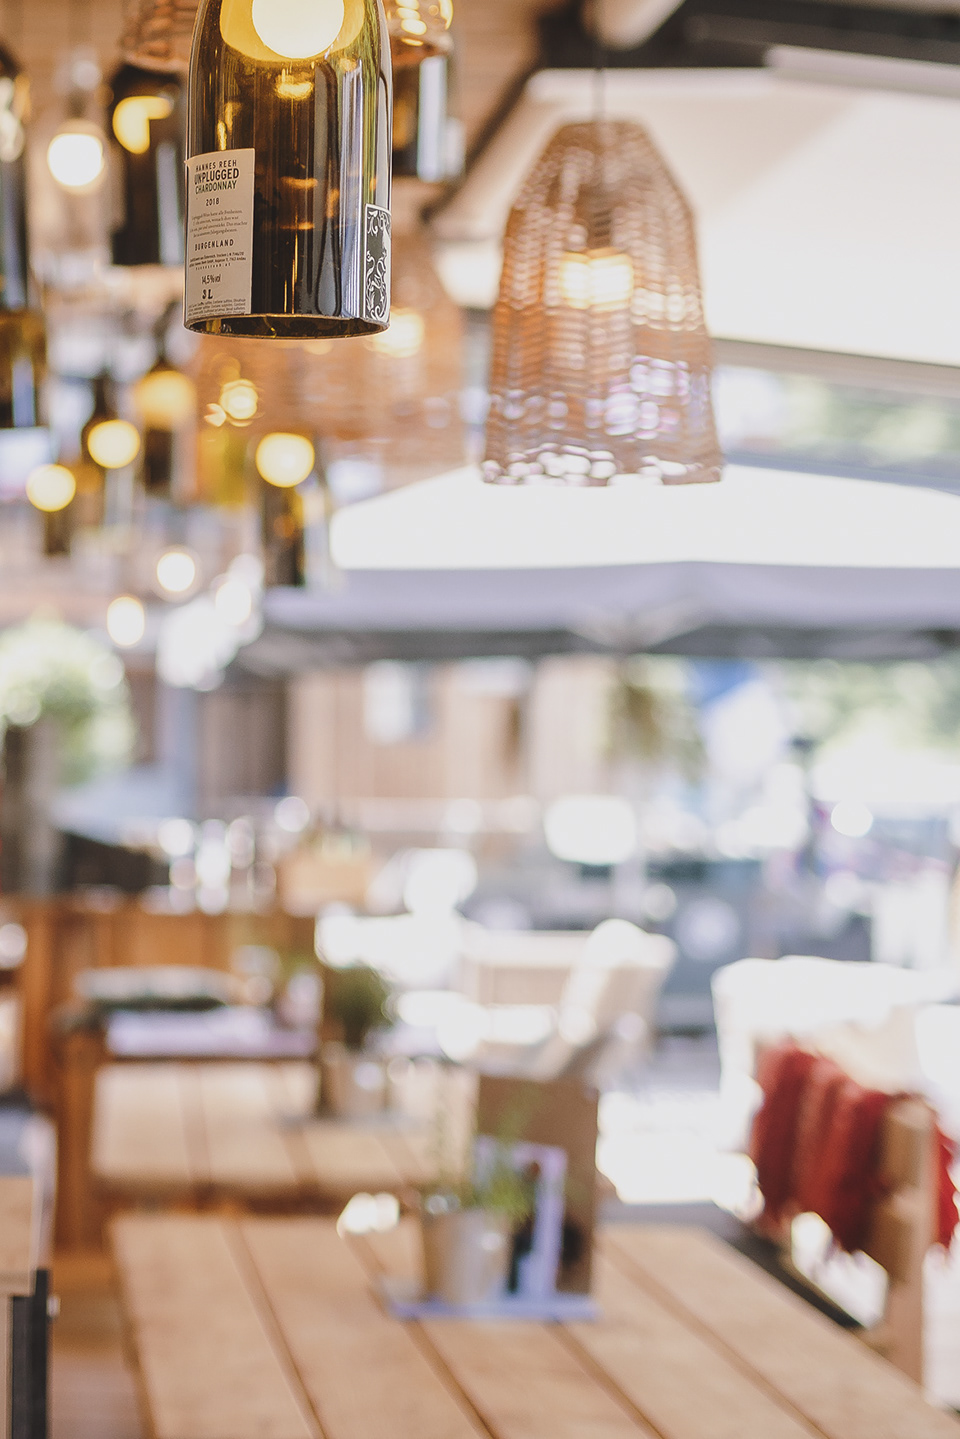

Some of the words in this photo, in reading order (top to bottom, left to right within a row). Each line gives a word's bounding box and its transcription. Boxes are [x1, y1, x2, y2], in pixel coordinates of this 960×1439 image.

[195, 161, 216, 172] HANNES
[218, 159, 237, 168] REEH
[194, 168, 239, 185] UNPLUGGED
[195, 180, 237, 194] CHARDONNAY
[206, 197, 220, 206] 2018
[194, 238, 234, 251] BURGENLAND
[202, 289, 207, 299] 3
[208, 289, 213, 299] L
